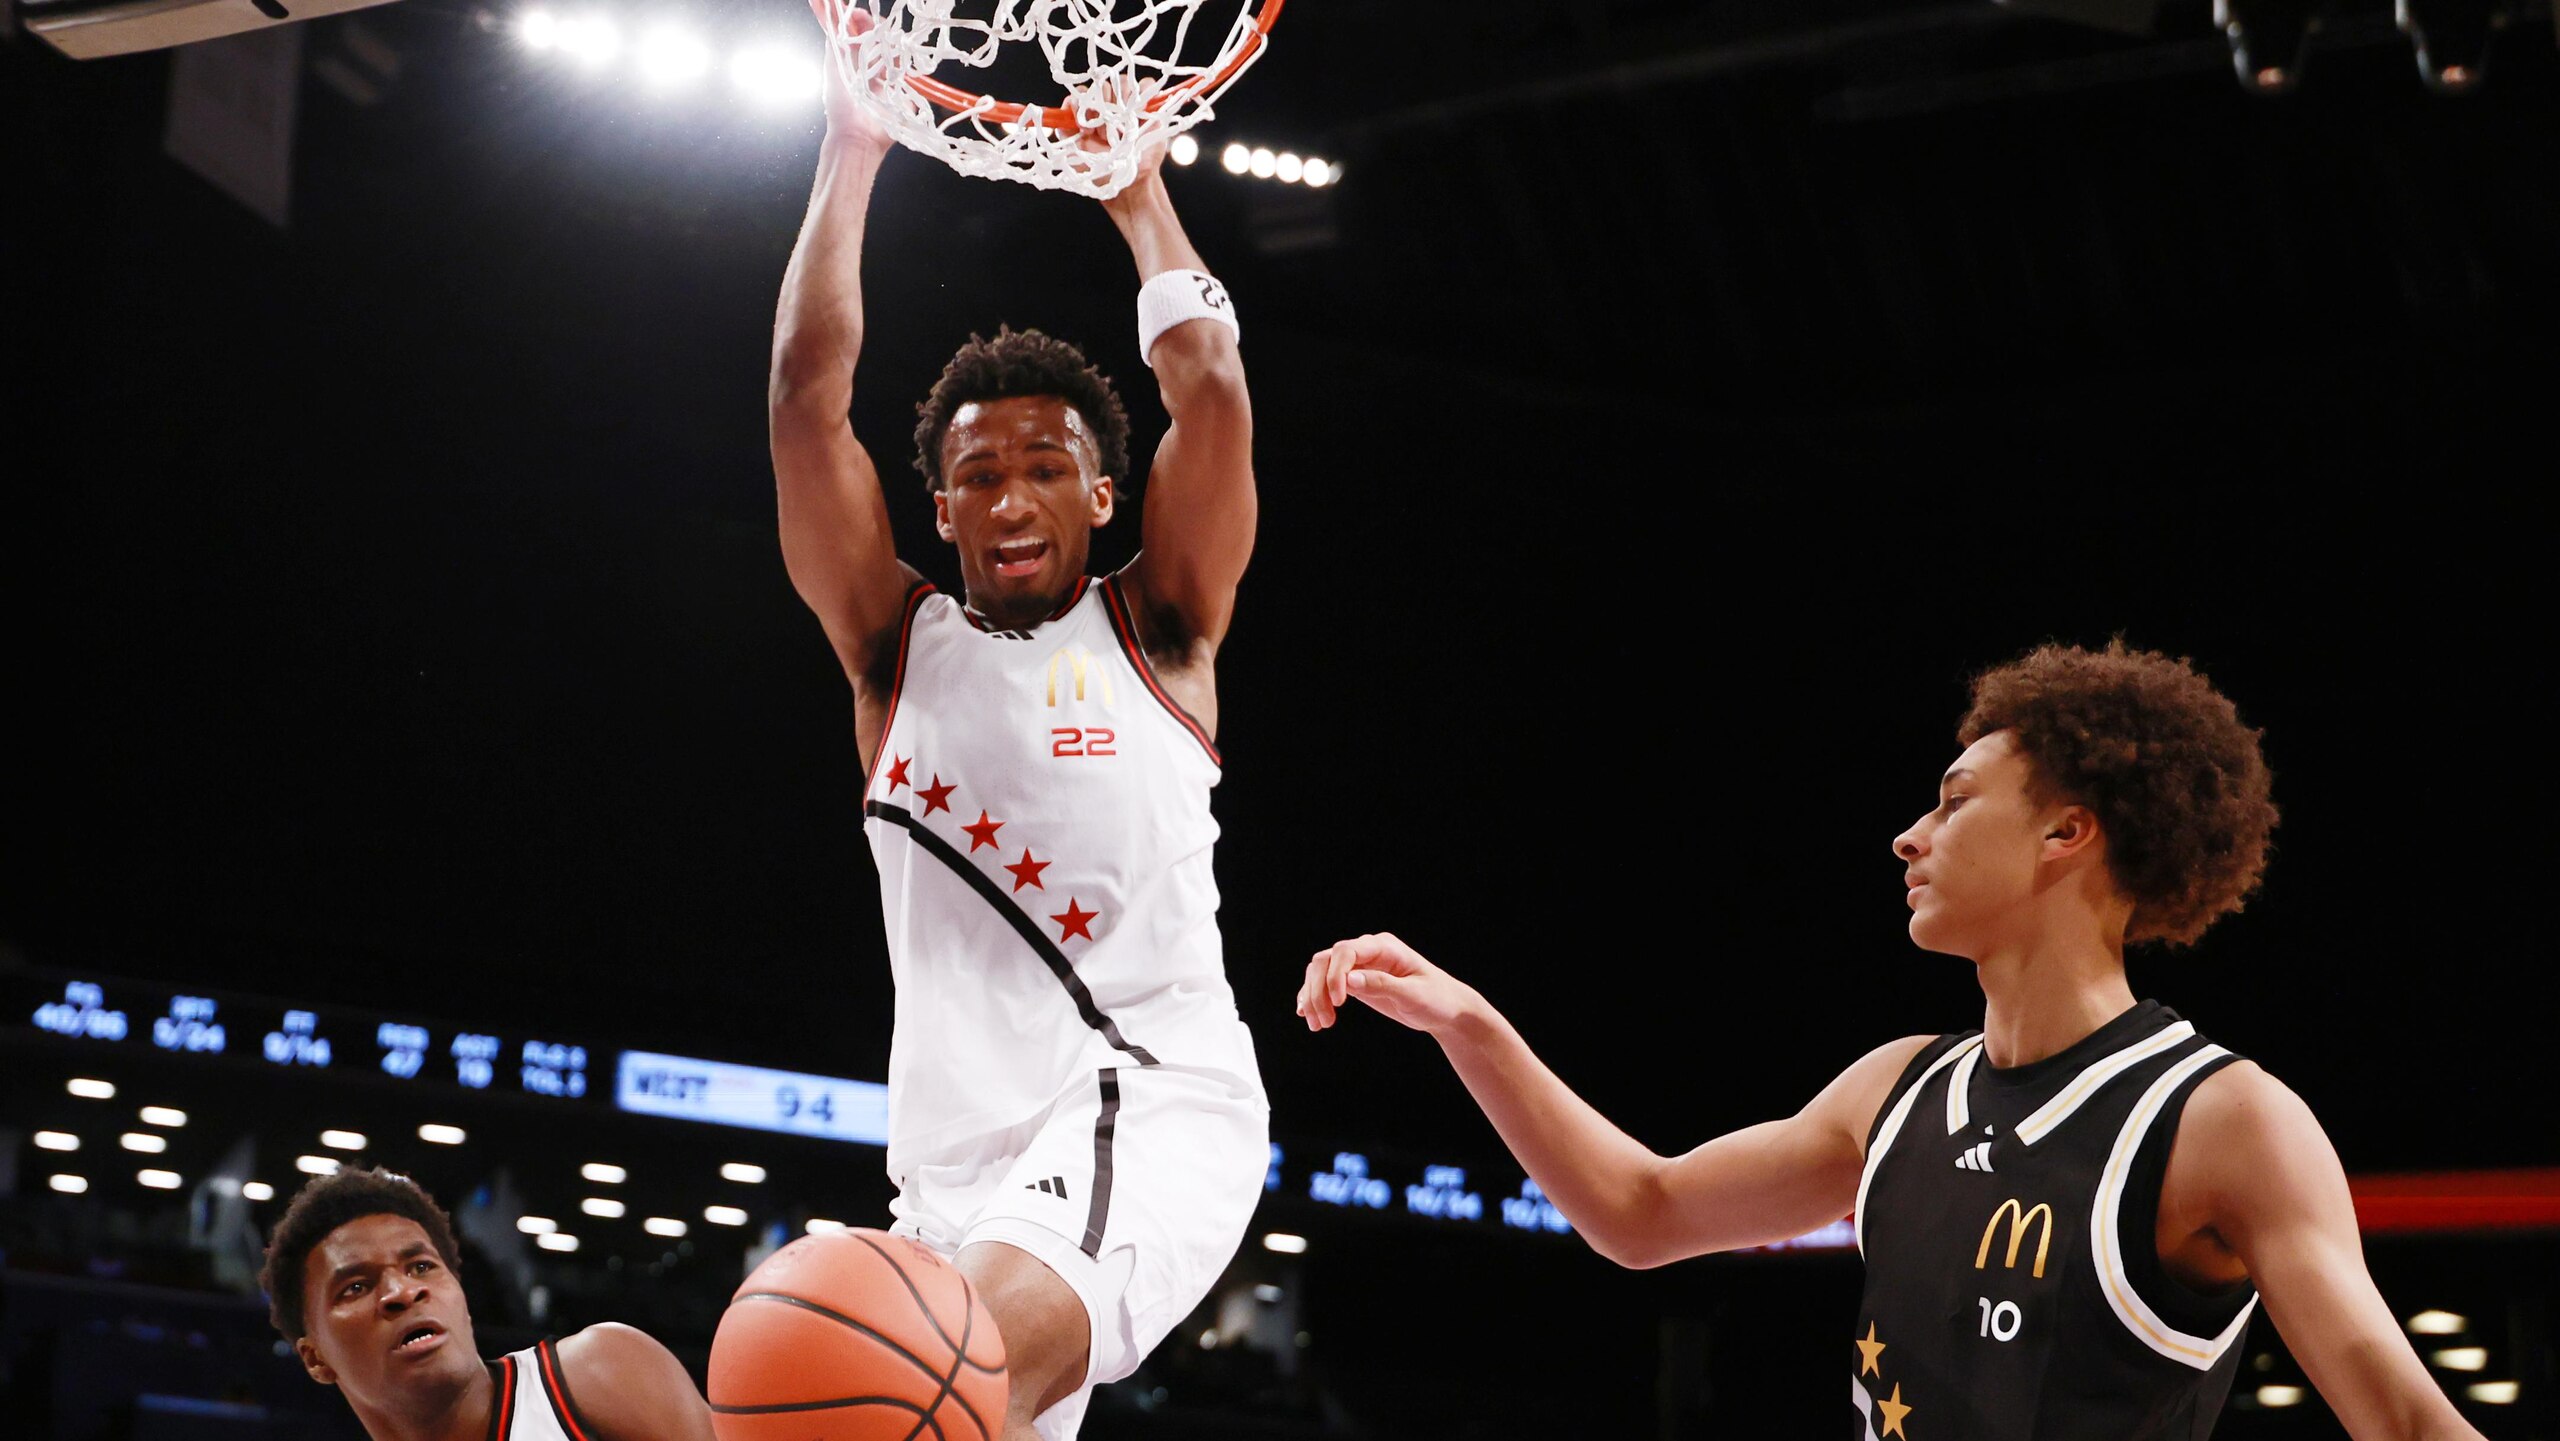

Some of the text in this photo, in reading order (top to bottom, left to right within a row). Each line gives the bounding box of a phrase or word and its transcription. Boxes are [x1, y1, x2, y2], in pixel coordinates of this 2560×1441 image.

[1050, 727, 1117, 757] 22
[775, 1084, 834, 1122] 94
[1978, 1296, 2022, 1342] 10
